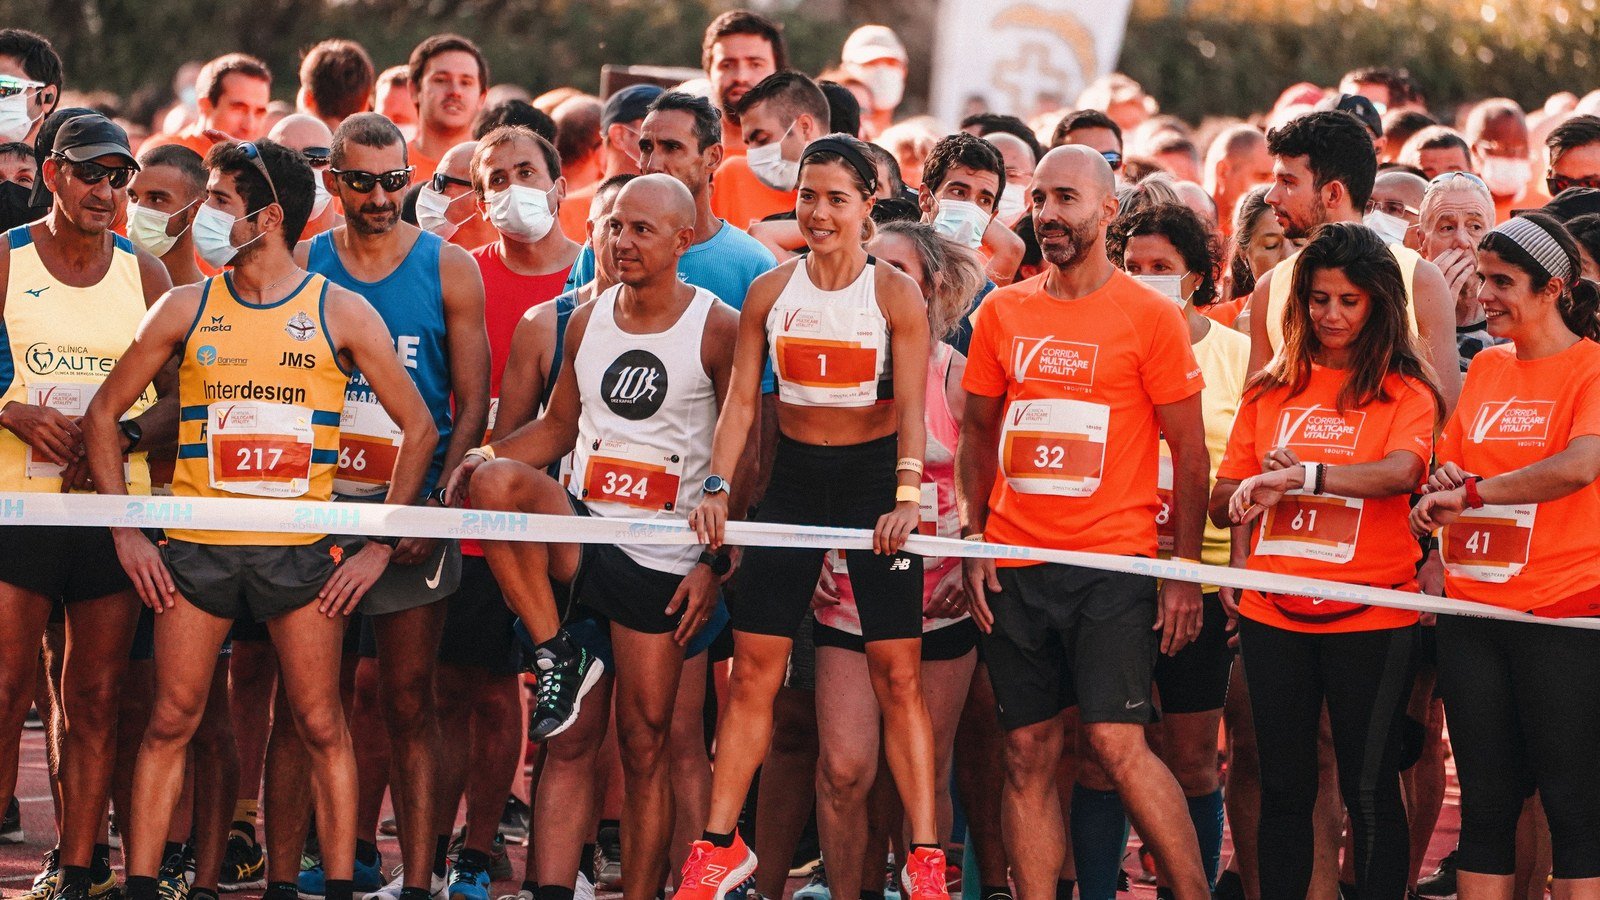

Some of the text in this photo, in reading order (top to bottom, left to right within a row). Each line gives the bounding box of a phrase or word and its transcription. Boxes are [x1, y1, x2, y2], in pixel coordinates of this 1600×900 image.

[200, 322, 232, 332] meta
[57, 345, 88, 354] CLÍNICA
[1042, 348, 1079, 359] CORRIDA
[55, 356, 118, 373] AUTE
[279, 351, 316, 369] JMS
[817, 354, 827, 377] 1
[1040, 356, 1089, 369] MULTICARE
[1038, 365, 1077, 376] VITALITY
[610, 366, 649, 399] 10
[203, 380, 306, 404] Interdesign
[1504, 409, 1538, 417] CORRIDA
[1308, 415, 1346, 425] CORRIDA
[1501, 416, 1545, 425] MULTICARE
[1305, 424, 1355, 435] MULTICARE
[1499, 424, 1534, 433] VITALITY
[1303, 431, 1343, 441] VITALITY
[236, 447, 284, 471] 217
[1033, 445, 1065, 469] 32
[601, 471, 649, 500] 324
[1291, 508, 1317, 532] 61
[1465, 530, 1491, 554] 41
